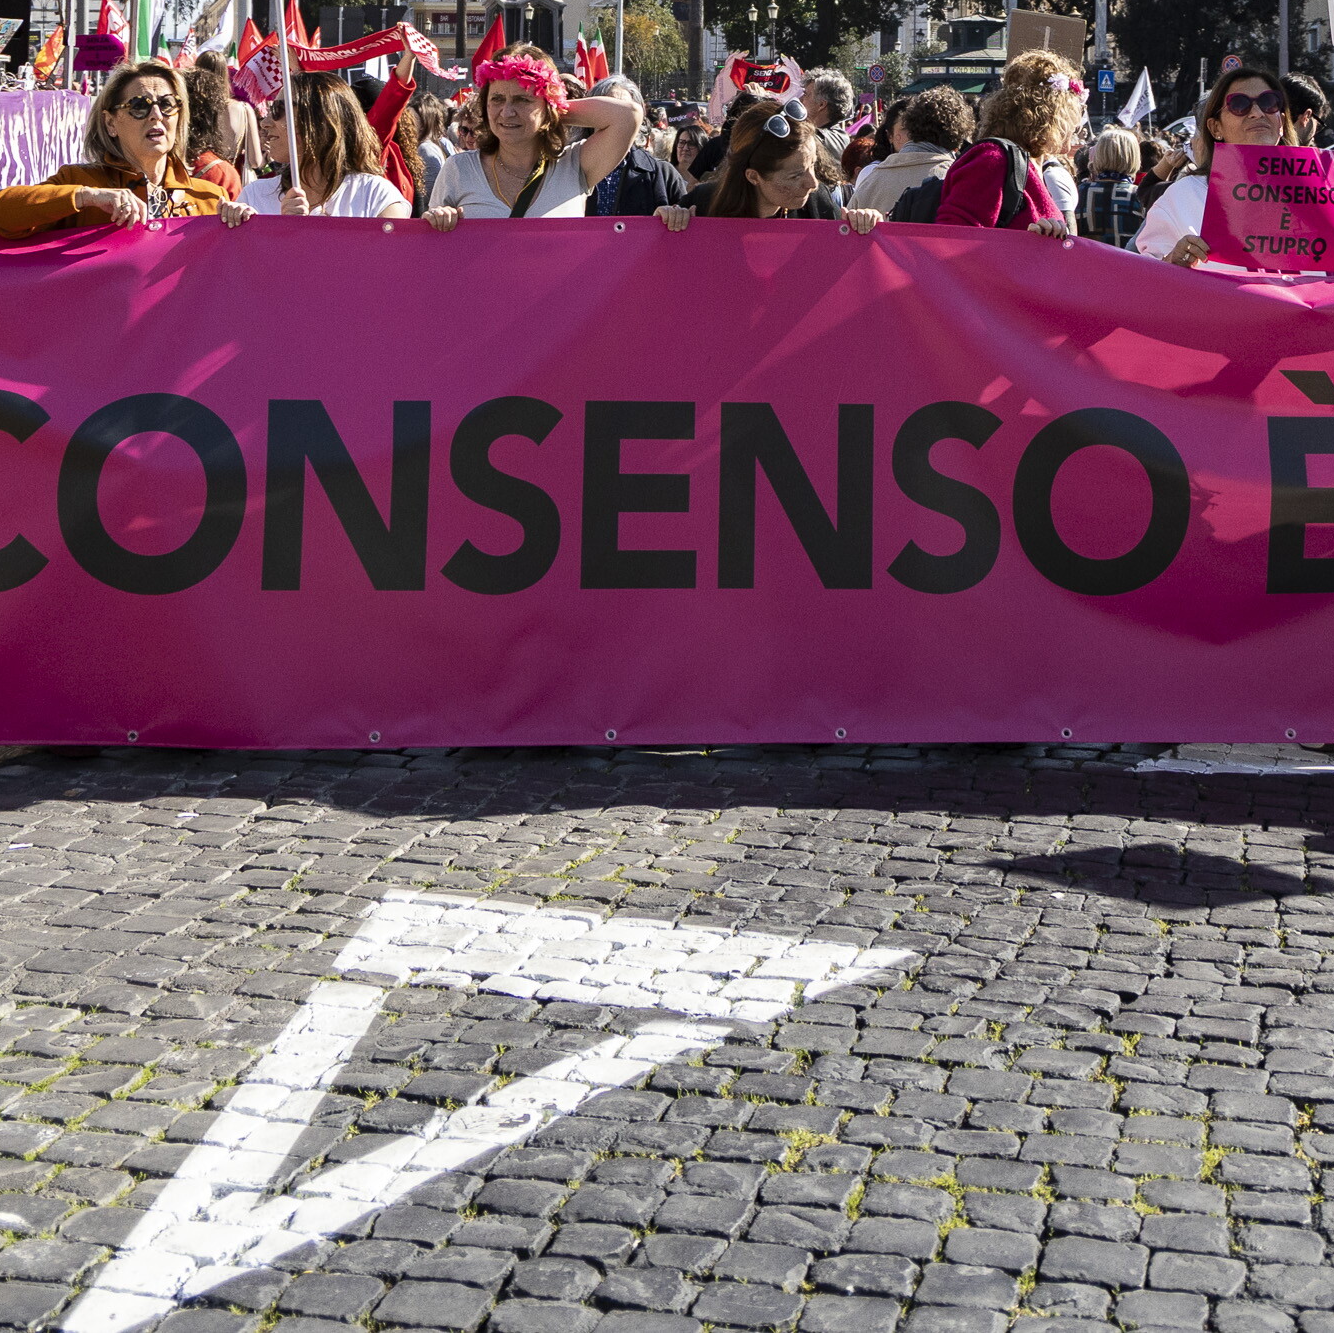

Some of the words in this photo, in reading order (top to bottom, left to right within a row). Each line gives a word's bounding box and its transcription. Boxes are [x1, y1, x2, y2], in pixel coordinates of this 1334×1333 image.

[1256, 156, 1320, 177] SENZA
[1279, 207, 1292, 230] È
[1242, 234, 1327, 261] STUPRO
